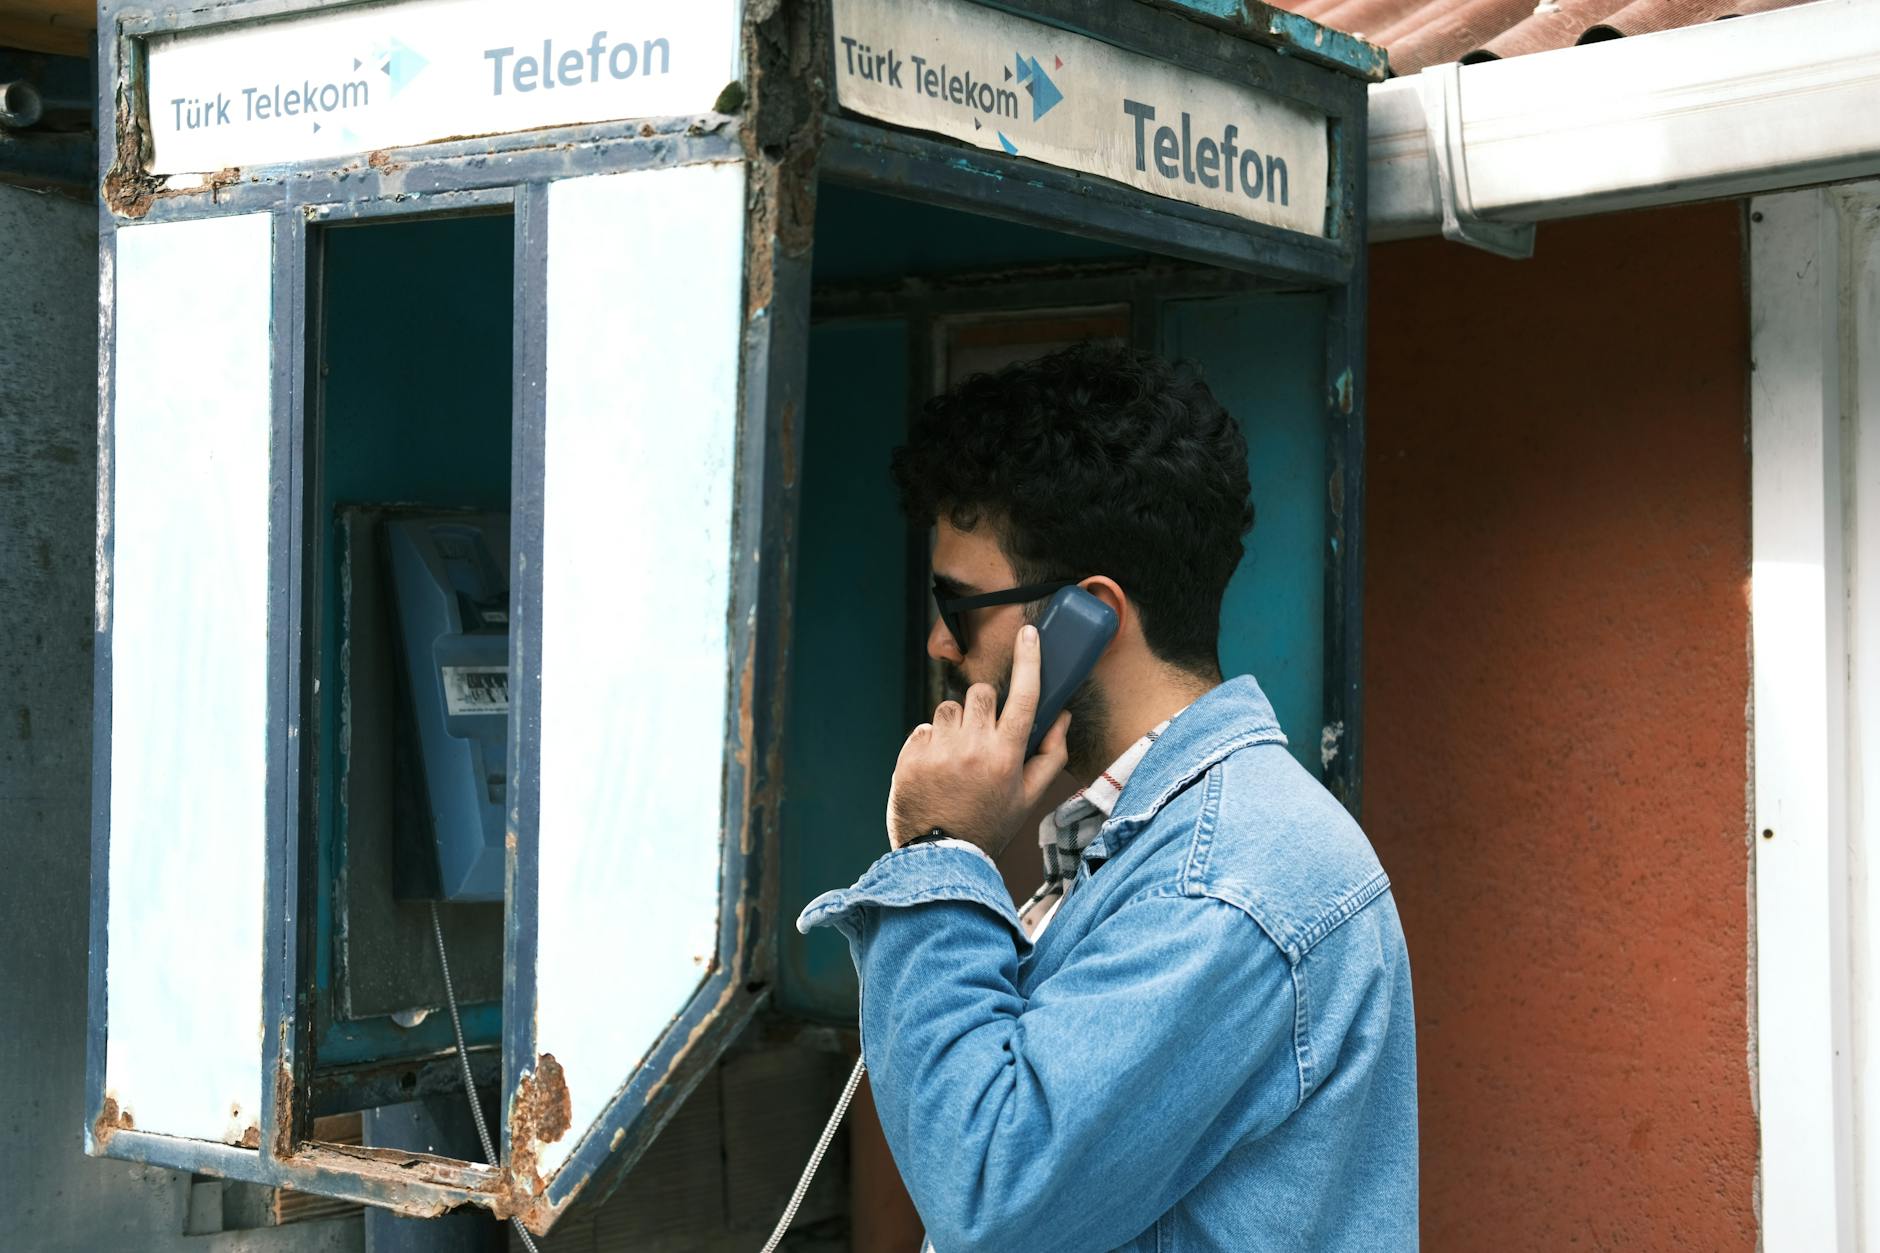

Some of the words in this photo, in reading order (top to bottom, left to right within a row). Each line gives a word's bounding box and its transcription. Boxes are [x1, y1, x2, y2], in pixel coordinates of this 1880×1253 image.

[484, 30, 671, 96] Telefon
[841, 37, 903, 88] Türk
[911, 55, 1019, 120] Telekom
[170, 92, 231, 131] Türk
[241, 79, 369, 121] Telekom
[1123, 98, 1290, 207] Telefon
